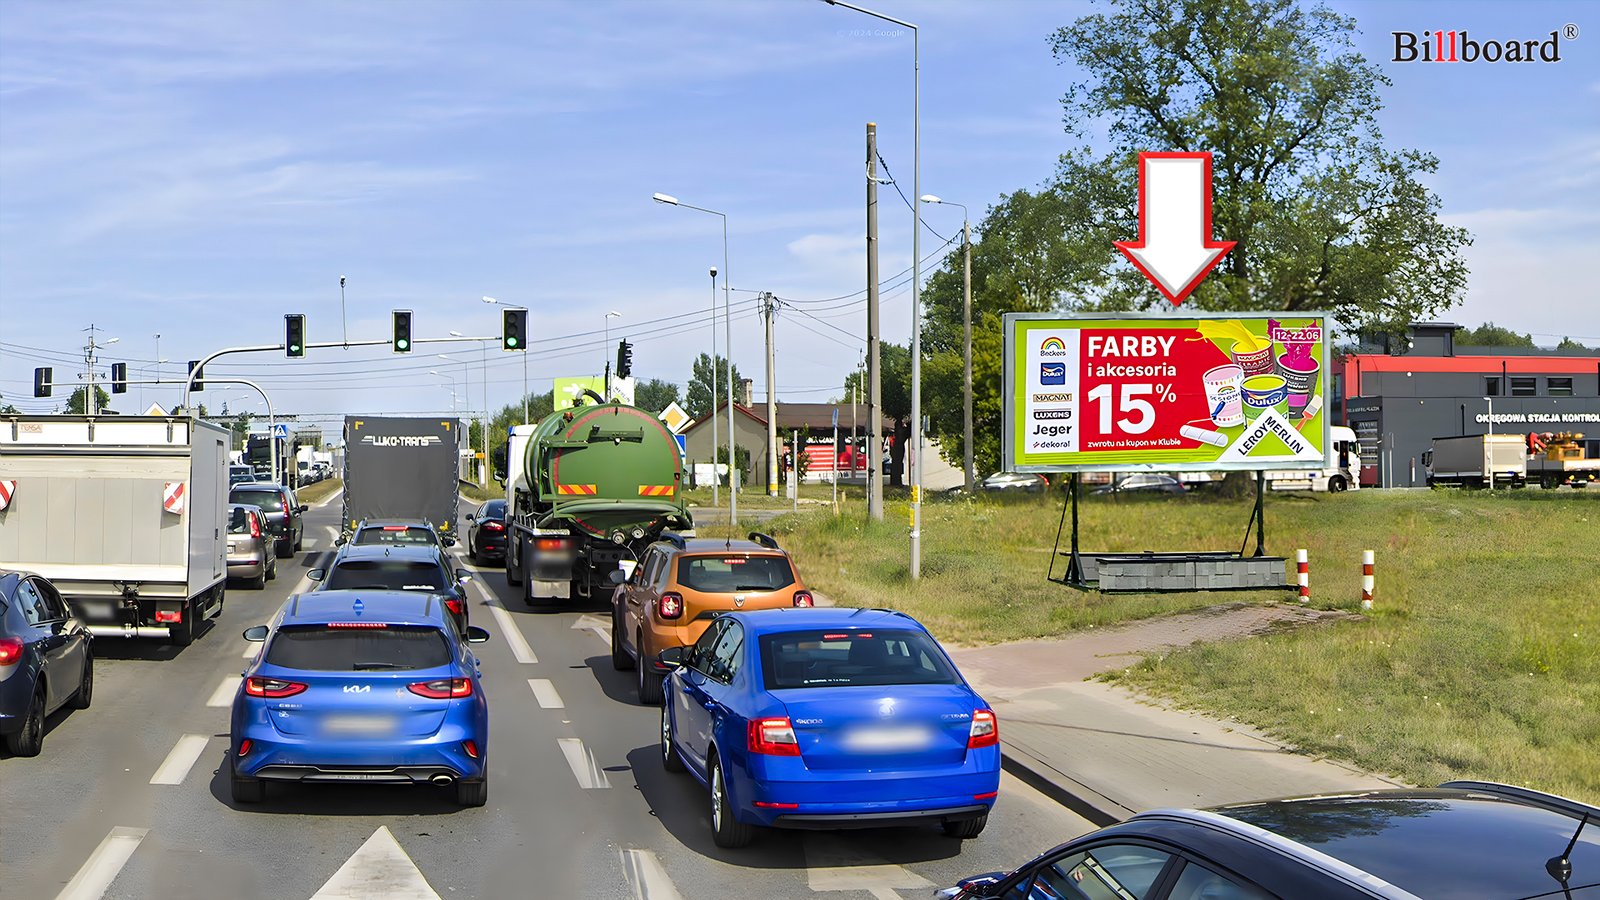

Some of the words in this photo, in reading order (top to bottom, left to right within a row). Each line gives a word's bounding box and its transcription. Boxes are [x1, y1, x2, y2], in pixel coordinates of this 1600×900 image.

[1088, 336, 1176, 357] FARBY
[1088, 363, 1092, 377] i
[1096, 362, 1177, 377] akcesoria
[1247, 396, 1280, 406] Dulux
[1527, 413, 1561, 423] STACJA
[1033, 424, 1072, 437] Jeger
[1238, 423, 1269, 456] LEROY
[1264, 415, 1304, 455] MERLIN
[1040, 440, 1071, 448] dekoral
[1088, 440, 1114, 448] zwrotu
[1126, 439, 1148, 448] kupon
